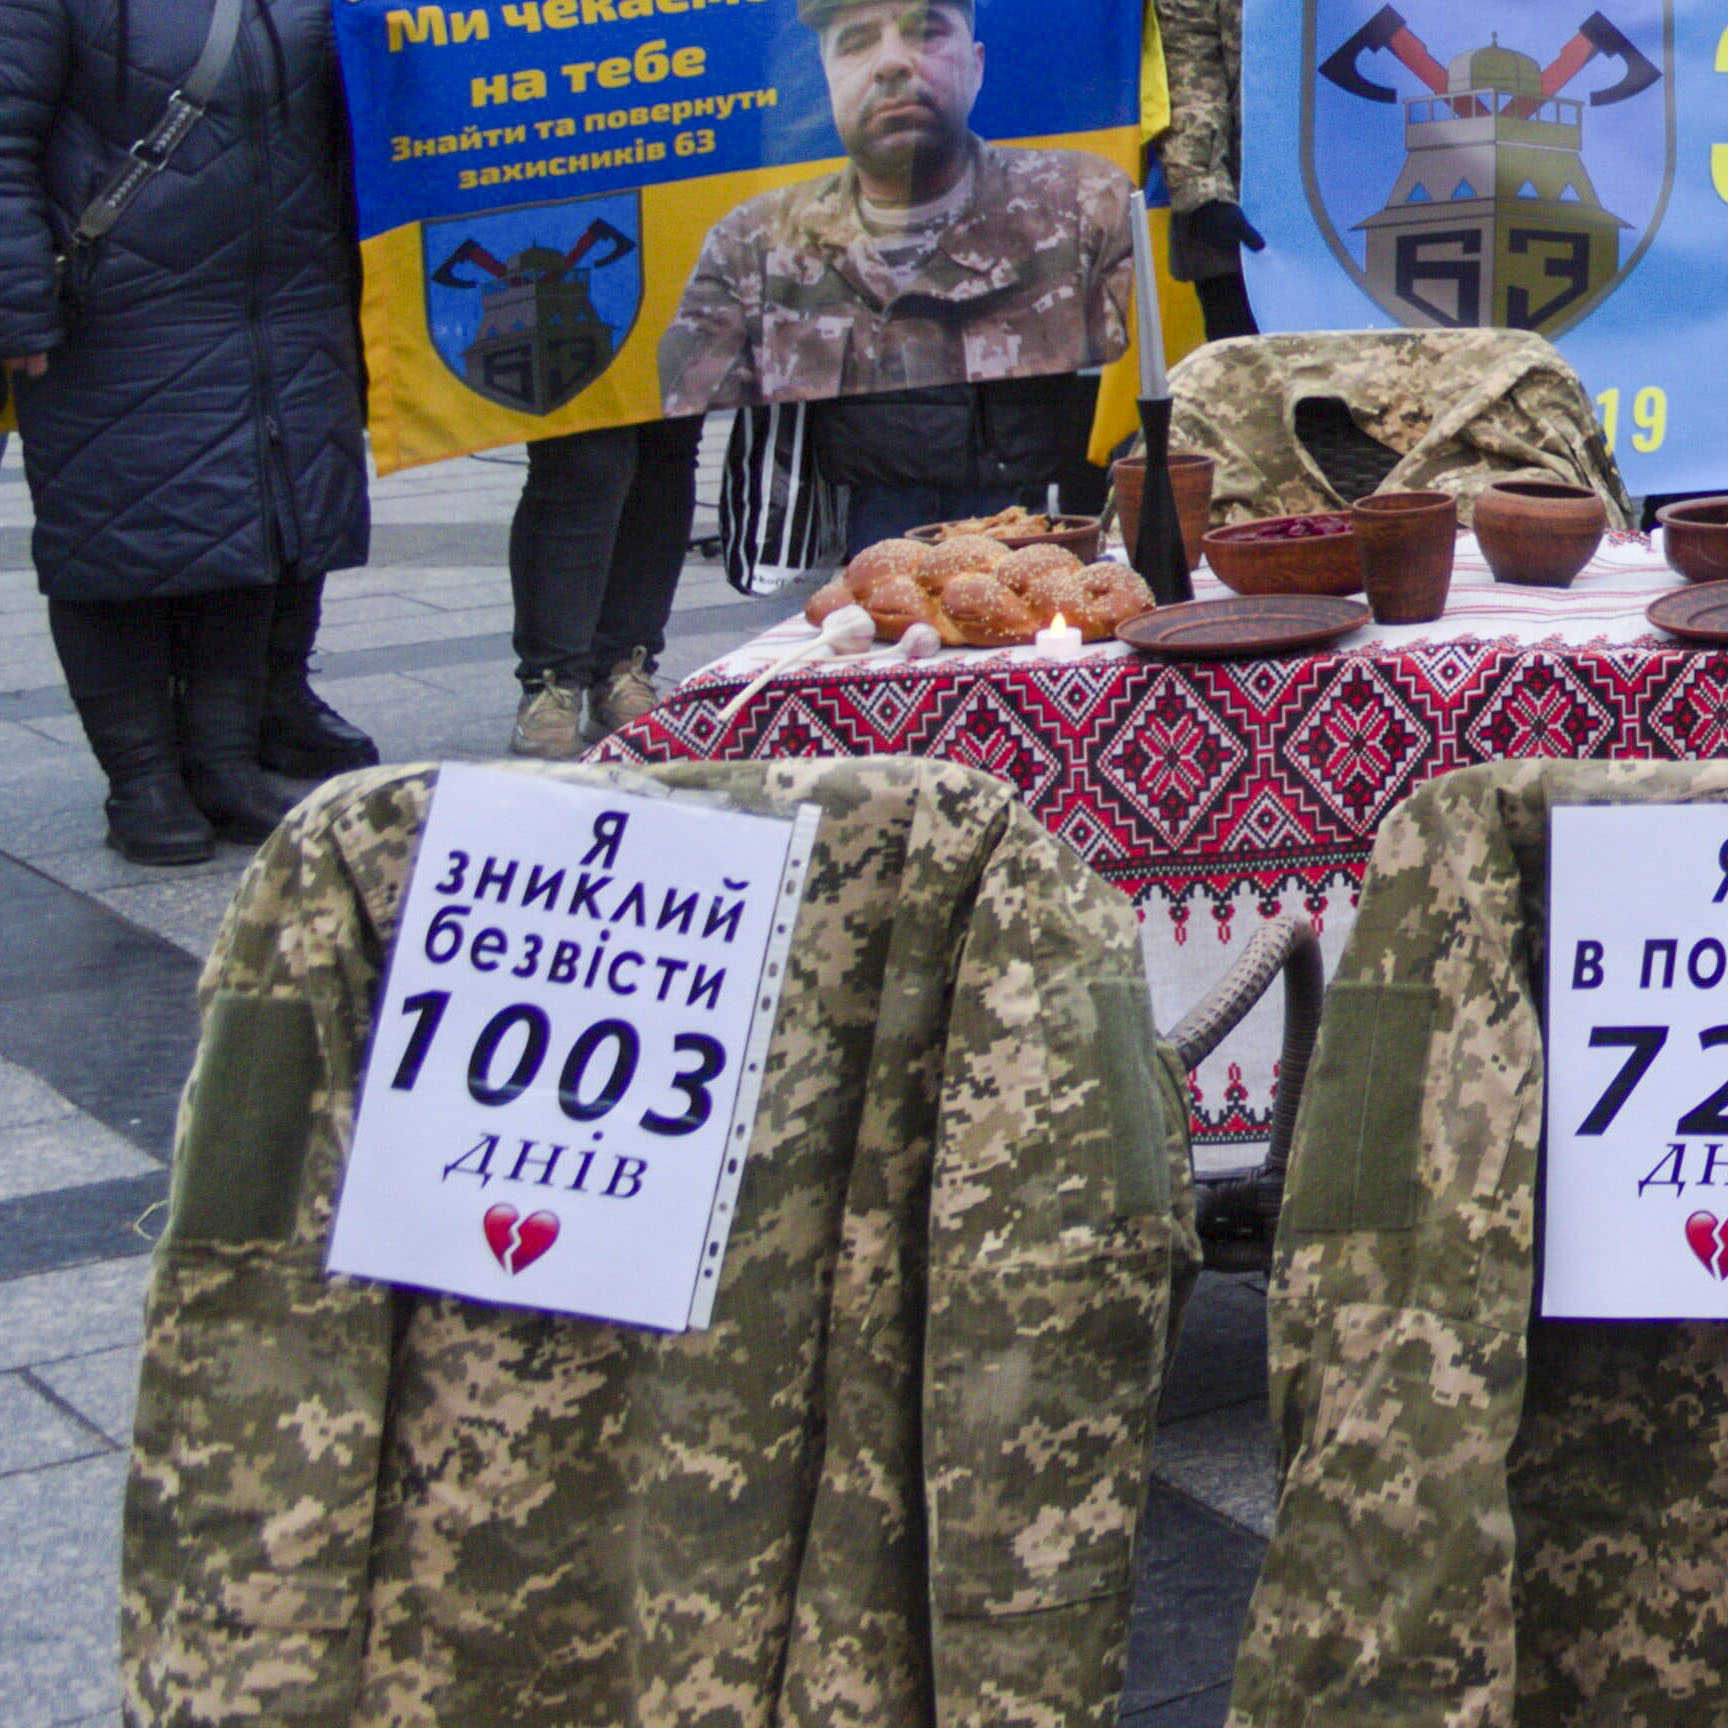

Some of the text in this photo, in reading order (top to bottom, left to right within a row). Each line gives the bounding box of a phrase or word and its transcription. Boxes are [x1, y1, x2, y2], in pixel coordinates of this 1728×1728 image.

[386, 5, 490, 53] Ми
[470, 38, 706, 108] на тебе
[390, 87, 778, 162] Знайти та повернути
[459, 128, 716, 190] захисників 63
[579, 810, 630, 870] Я
[435, 850, 749, 943] зниклий
[424, 905, 726, 1010] безвісти
[390, 989, 728, 1137] 1003
[442, 1129, 648, 1200] днів
